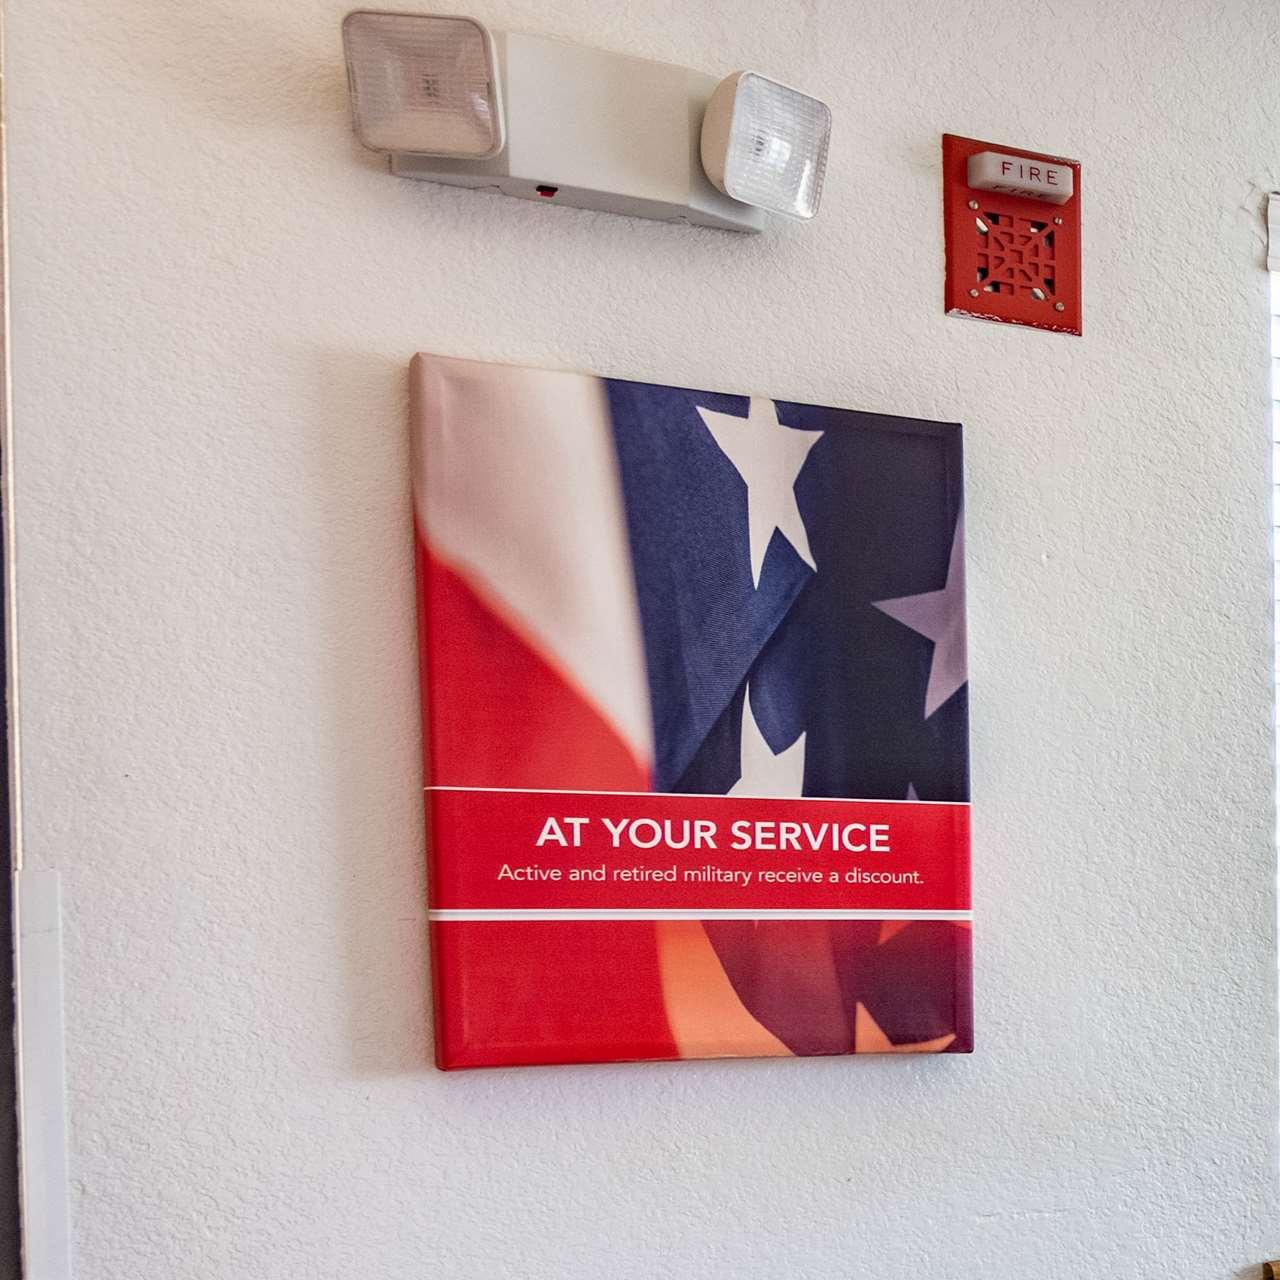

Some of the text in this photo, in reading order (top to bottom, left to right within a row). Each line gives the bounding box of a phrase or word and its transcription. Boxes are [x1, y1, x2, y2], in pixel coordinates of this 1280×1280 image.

[1001, 161, 1059, 186] FIRE
[535, 816, 891, 853] AT YOUR SERVICE
[497, 864, 925, 887] Active and retired military receive a discount.
